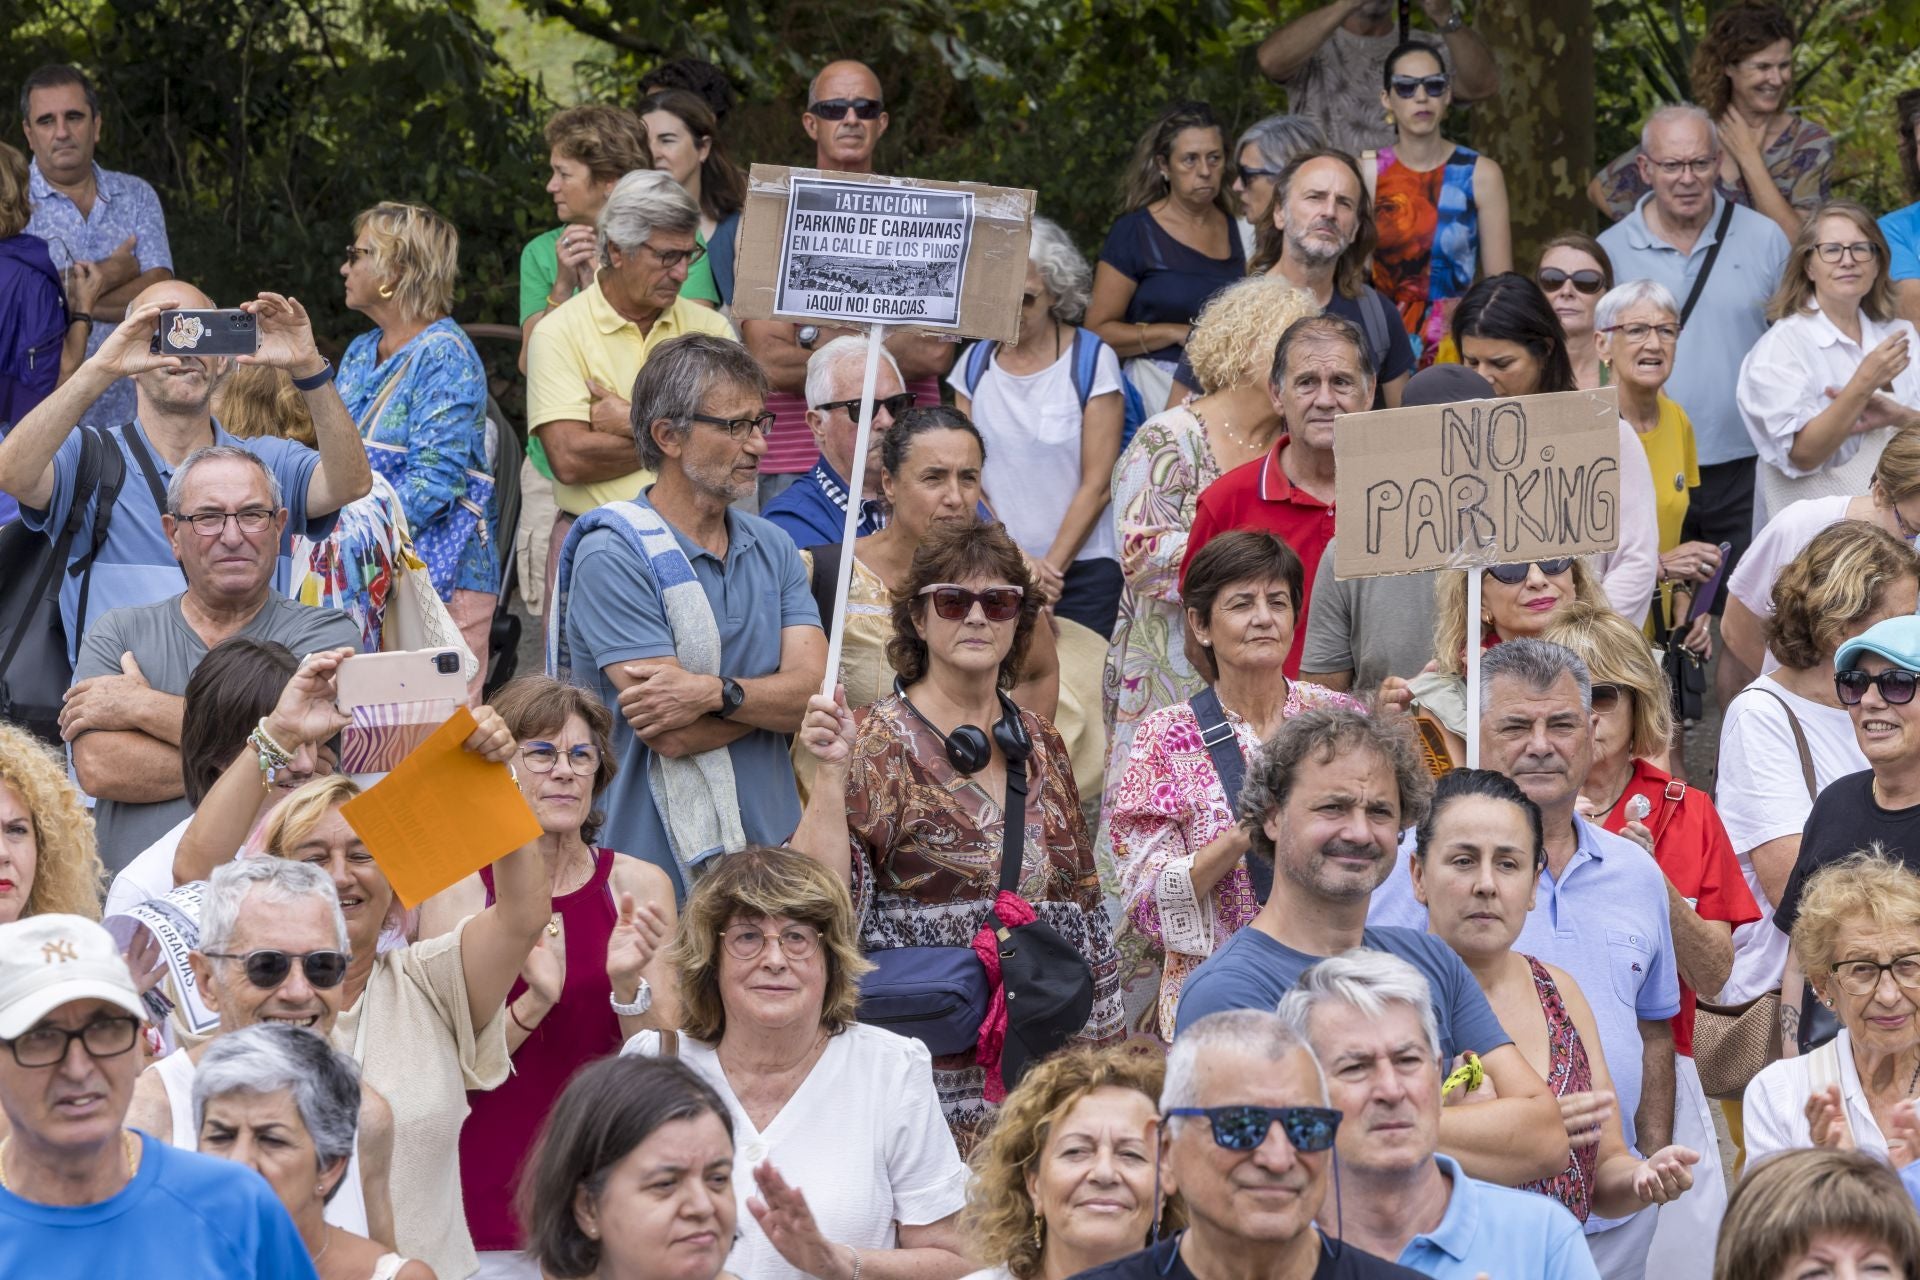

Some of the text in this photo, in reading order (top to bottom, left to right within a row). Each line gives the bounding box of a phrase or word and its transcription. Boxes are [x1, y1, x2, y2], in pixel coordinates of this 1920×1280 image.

[836, 193, 928, 215] ¡ATENCIÓN!
[795, 214, 963, 240] PARKING DE CARAVANAS
[792, 235, 960, 259] EN LA CALLE DE LOS PINOS
[806, 293, 928, 315] ¡AQUÍ NO! GRACIAS.
[1441, 402, 1527, 476] NO
[159, 924, 196, 992] GRACIAS.
